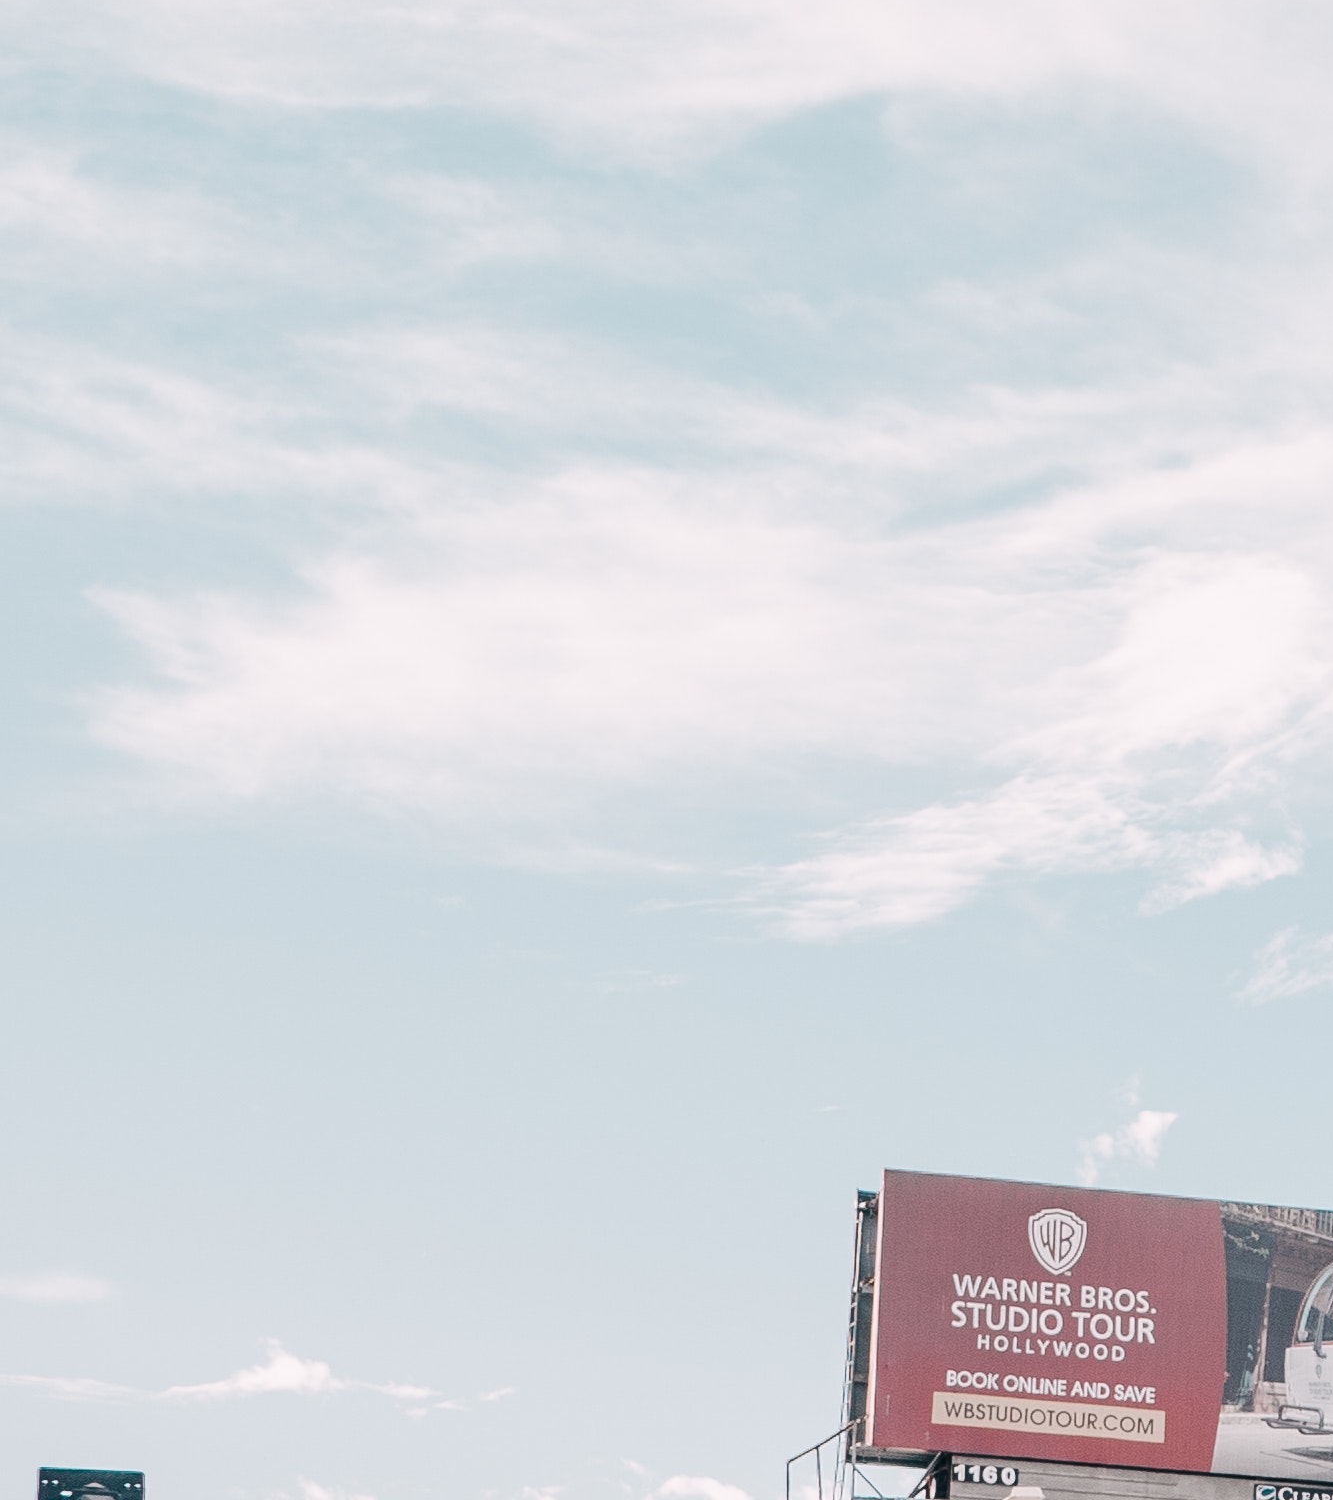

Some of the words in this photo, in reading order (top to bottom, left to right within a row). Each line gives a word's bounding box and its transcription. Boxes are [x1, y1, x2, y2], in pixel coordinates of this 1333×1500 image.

[952, 1273, 1072, 1307] WARNER
[1080, 1285, 1157, 1315] BROS.
[951, 1301, 1064, 1336] STUDIO
[1072, 1310, 1156, 1345] TOUR
[977, 1334, 1126, 1362] HOLLYWOOD
[946, 1369, 999, 1390] BOOK
[1003, 1373, 1067, 1397] ONLINE
[1071, 1380, 1110, 1400] AND
[1113, 1384, 1156, 1404] SAVE
[944, 1400, 1154, 1435] WBSTUDIOTOUR.COM
[954, 1464, 1017, 1486] 1160
